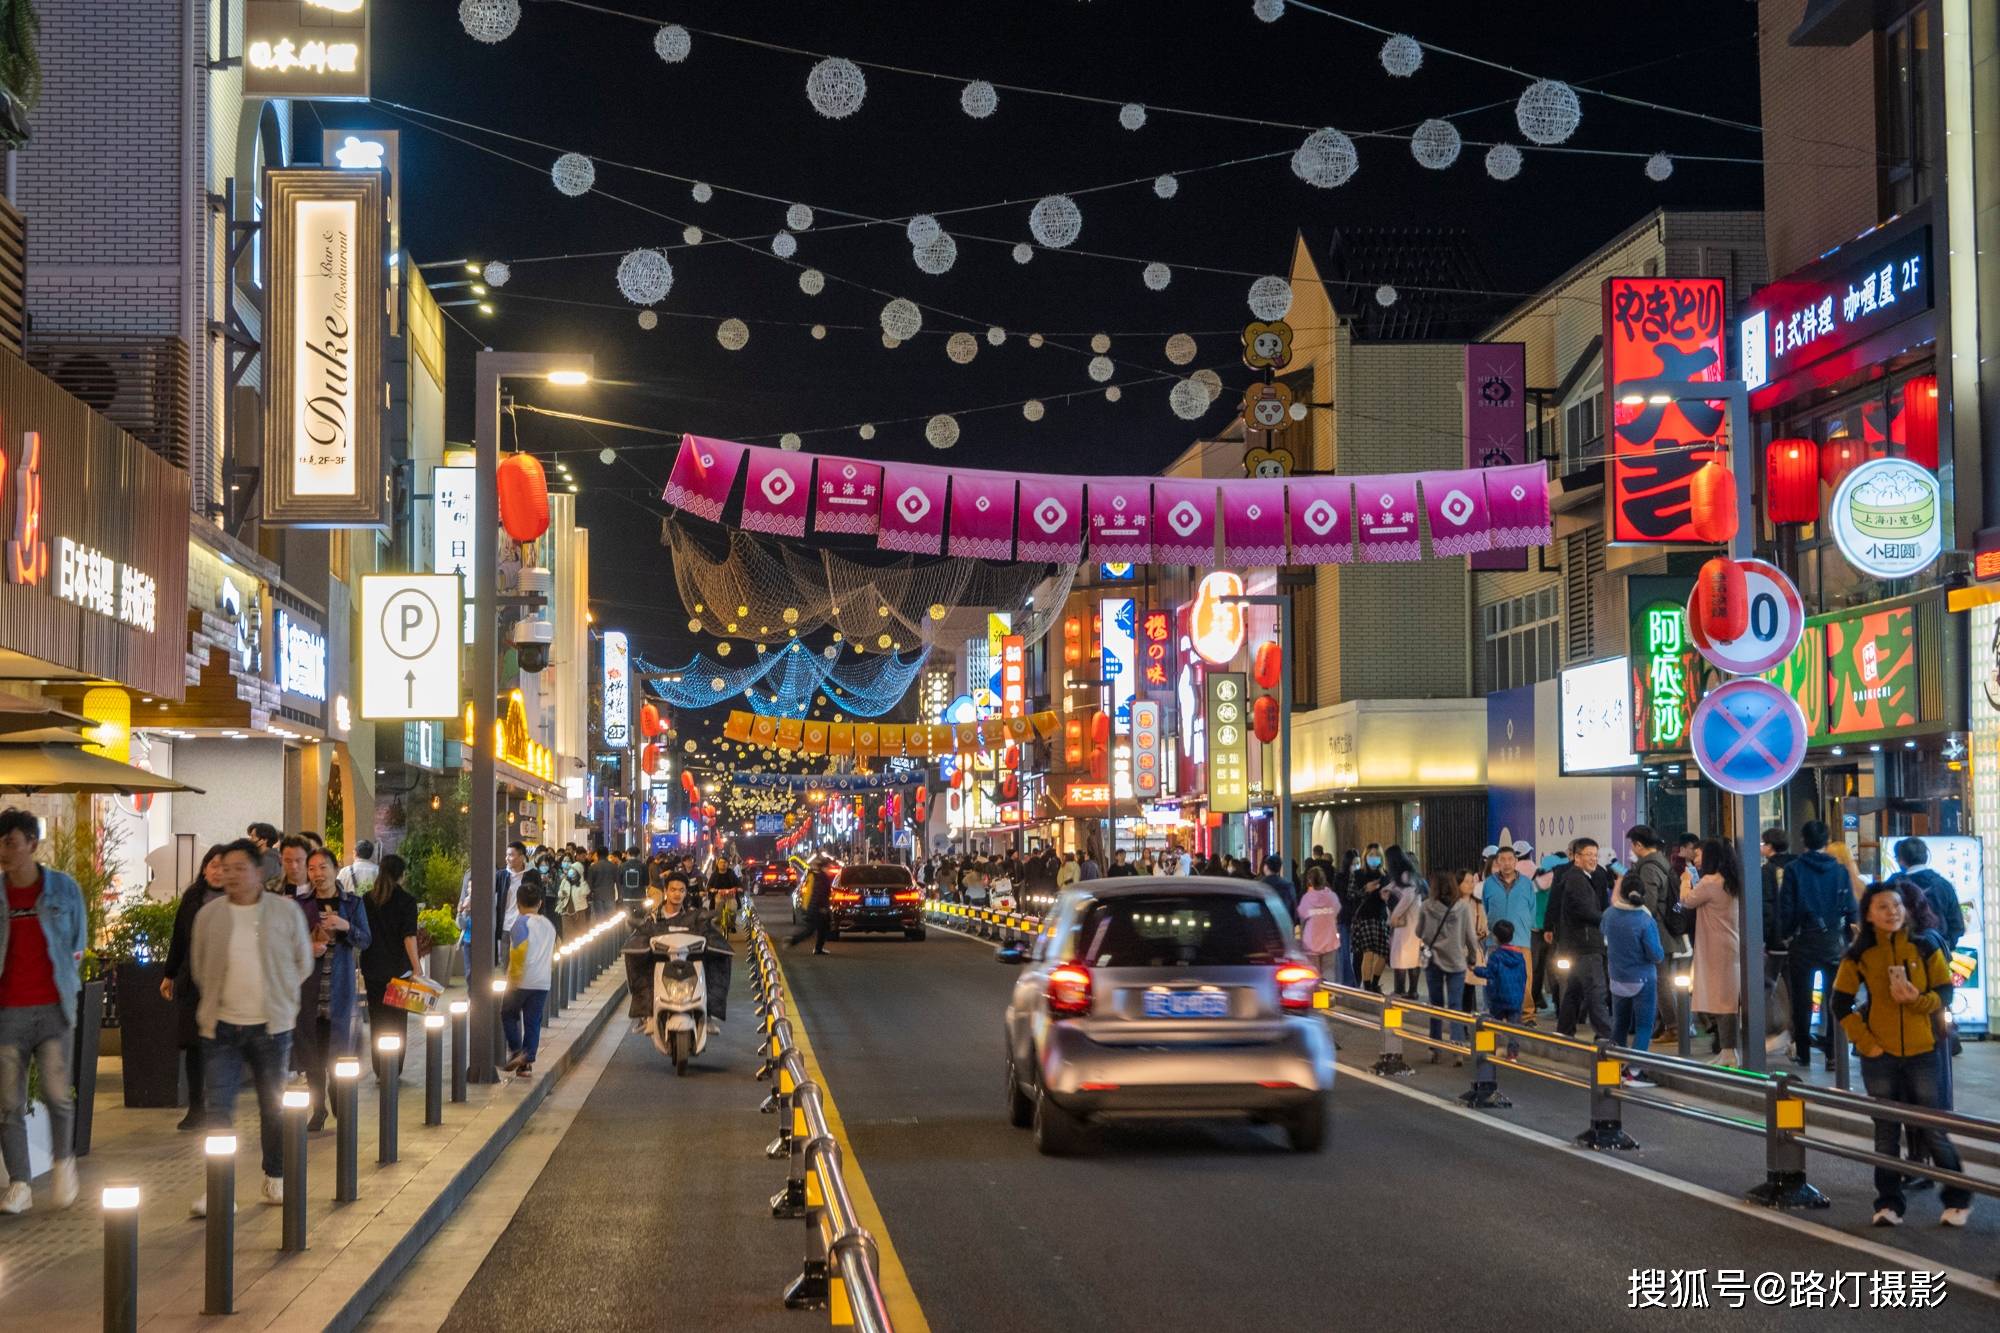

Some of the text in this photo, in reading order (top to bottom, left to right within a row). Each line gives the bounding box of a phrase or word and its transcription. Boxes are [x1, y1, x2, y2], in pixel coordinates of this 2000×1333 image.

[321, 246, 334, 278] Bar
[332, 231, 348, 310] Restaurant
[1615, 284, 1721, 342] やきとり
[1775, 295, 1835, 359] 日式料理
[1902, 255, 1921, 292] 2F
[303, 310, 349, 449] Duke
[318, 456, 347, 465] 2F-3F
[822, 481, 876, 496] 淮海街
[1092, 514, 1147, 527] 淮海街
[1361, 512, 1415, 526] 淮海街
[1866, 543, 1915, 559] 小团圆
[58, 536, 115, 617] 日本料理
[401, 604, 424, 642] P
[1751, 592, 1778, 642] 0
[1650, 610, 1684, 743] 阿依莎
[1853, 686, 1891, 702] DAIKICHI
[608, 727, 625, 738] 2F
